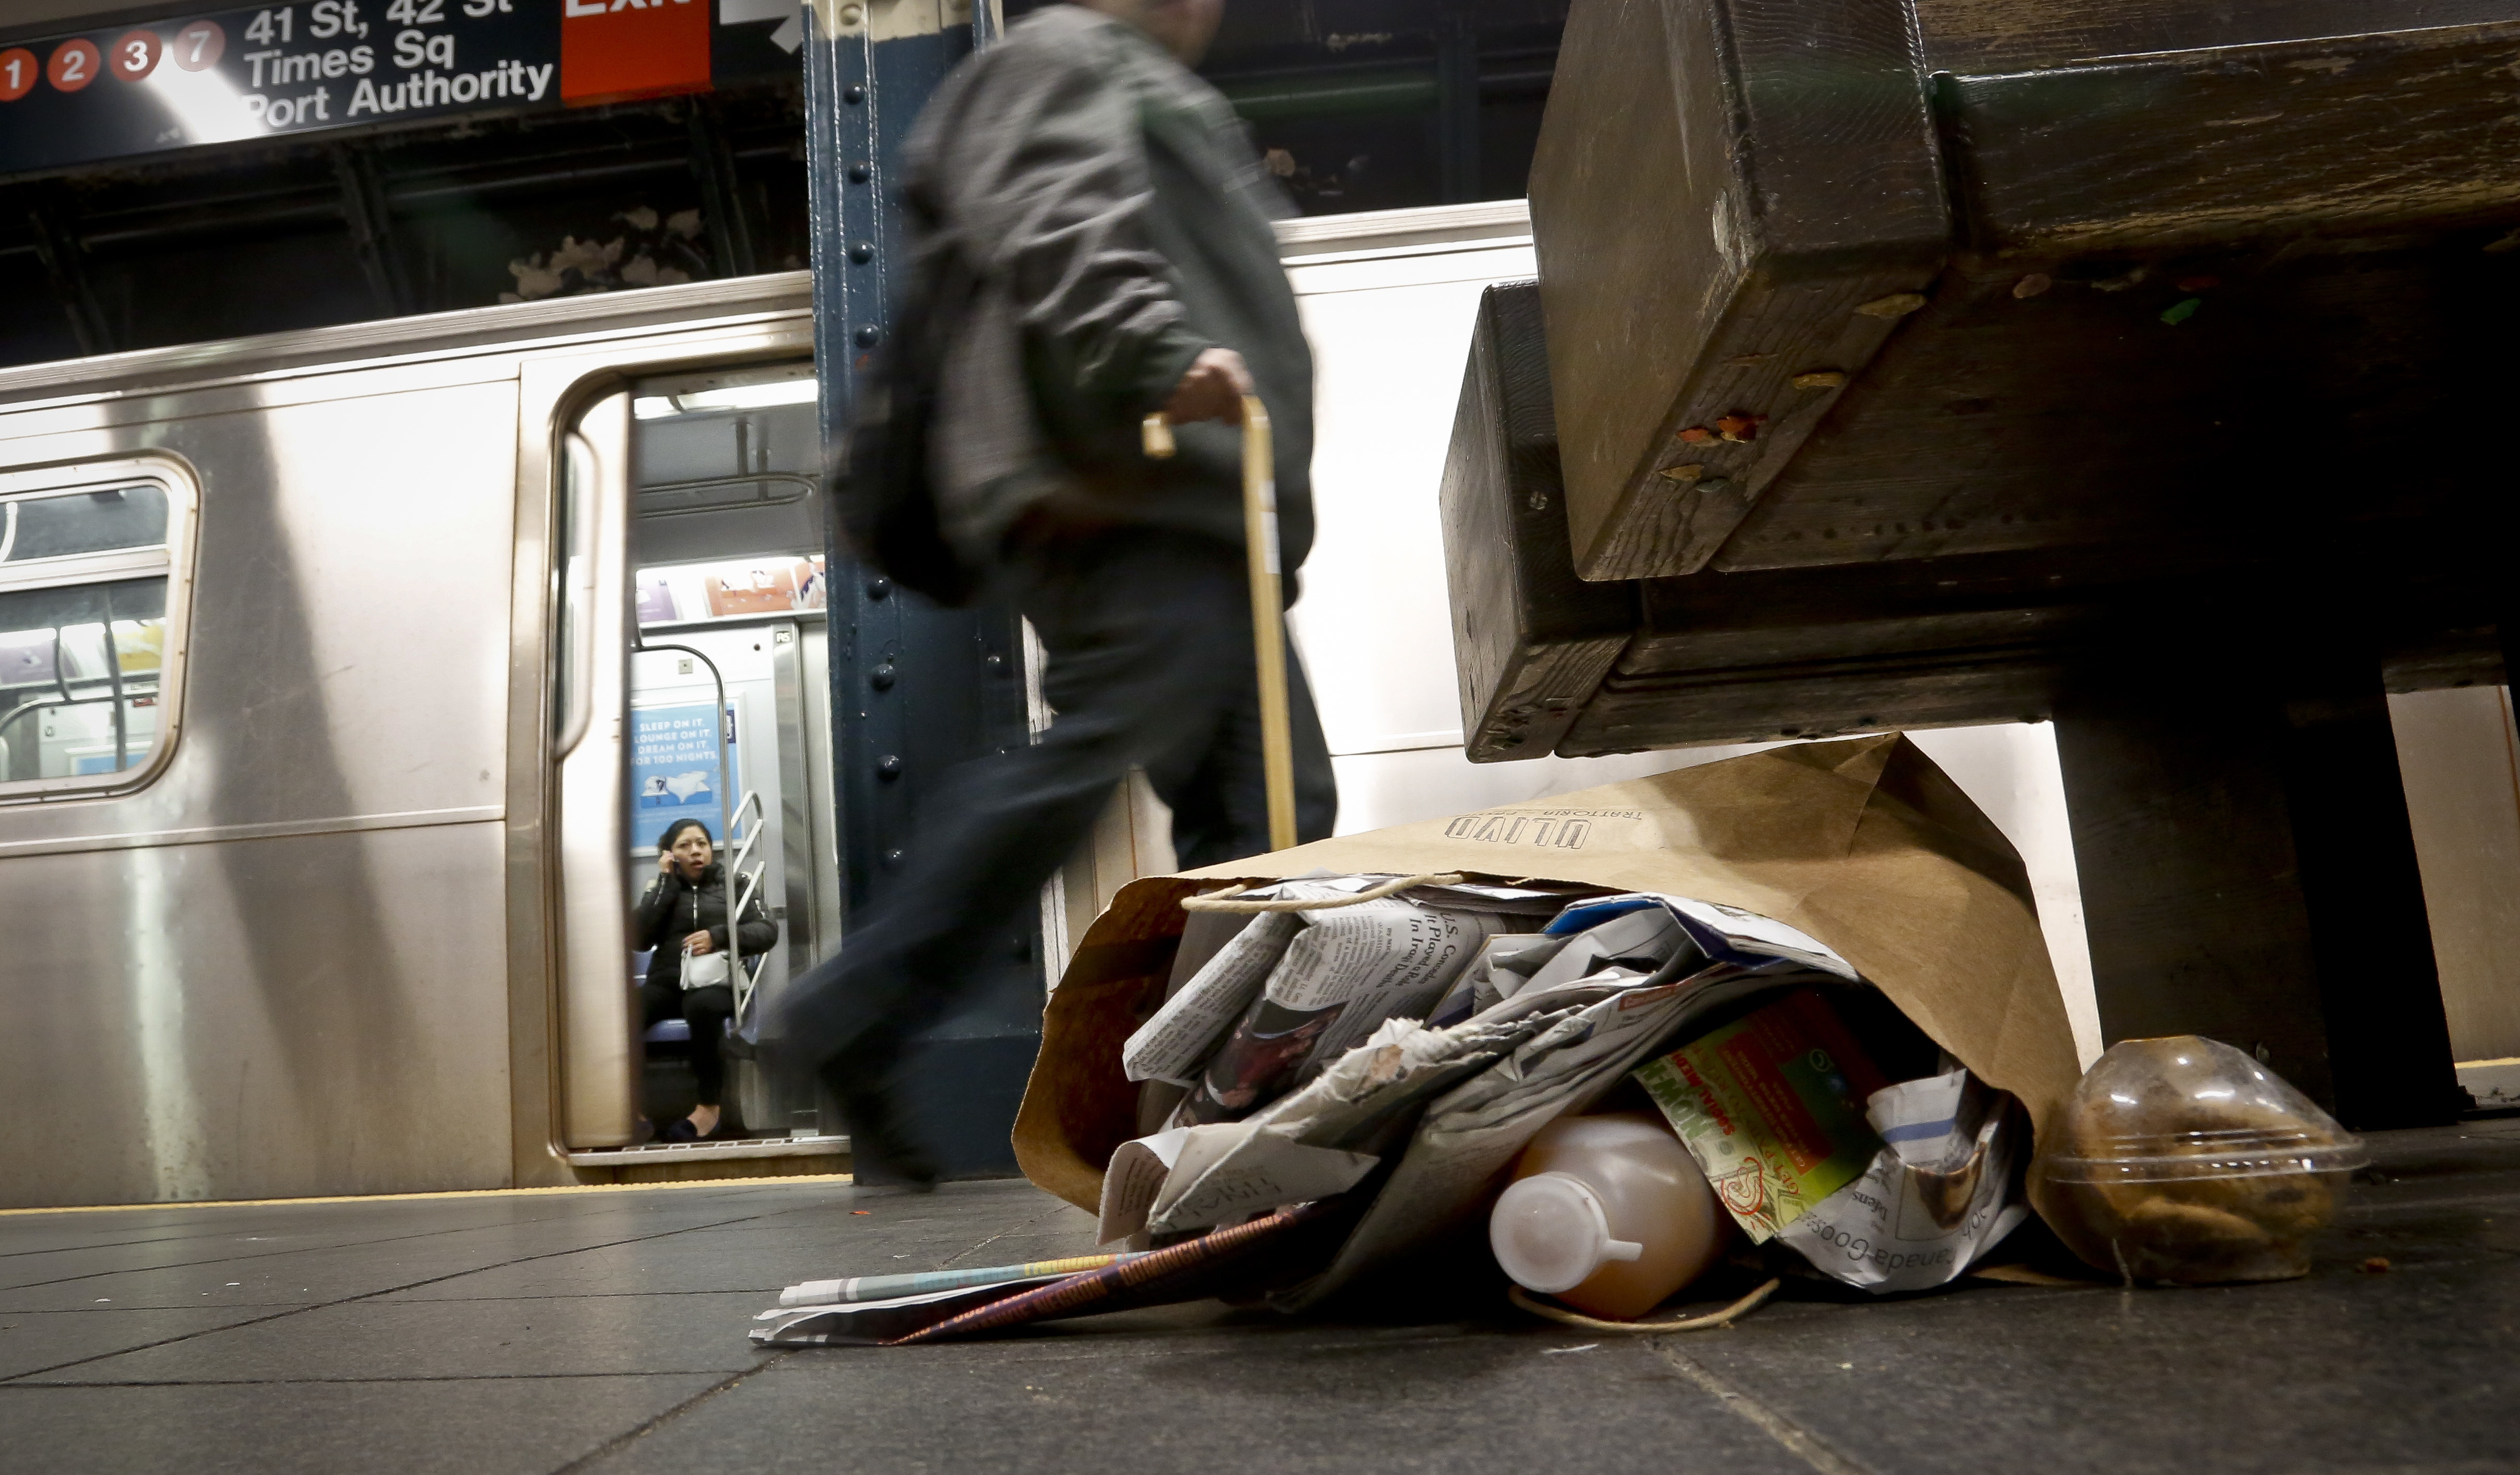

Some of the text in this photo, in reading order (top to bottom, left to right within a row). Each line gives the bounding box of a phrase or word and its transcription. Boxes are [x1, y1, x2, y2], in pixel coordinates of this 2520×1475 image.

[244, 6, 293, 45] 41
[310, 0, 368, 39] St,
[386, 0, 445, 26] 42
[5, 30, 210, 89] 1 2 3 7
[243, 29, 454, 88] Times Sq
[243, 60, 553, 127] Port Authority
[634, 732, 678, 744] LOUNGE
[680, 731, 696, 739] ON
[640, 721, 671, 731] SLEEP
[673, 719, 690, 729] ON
[638, 744, 675, 753] DREAM
[678, 742, 693, 750] ON
[654, 754, 673, 763] 100
[1543, 810, 1642, 820] TRATTORIA
[1410, 918, 1422, 932] In
[1425, 914, 1436, 923] It
[1440, 913, 1458, 938] U.S.
[1418, 926, 1441, 966] Played
[1699, 1089, 1736, 1136] SOCIAL
[1774, 1163, 1800, 1195] GET
